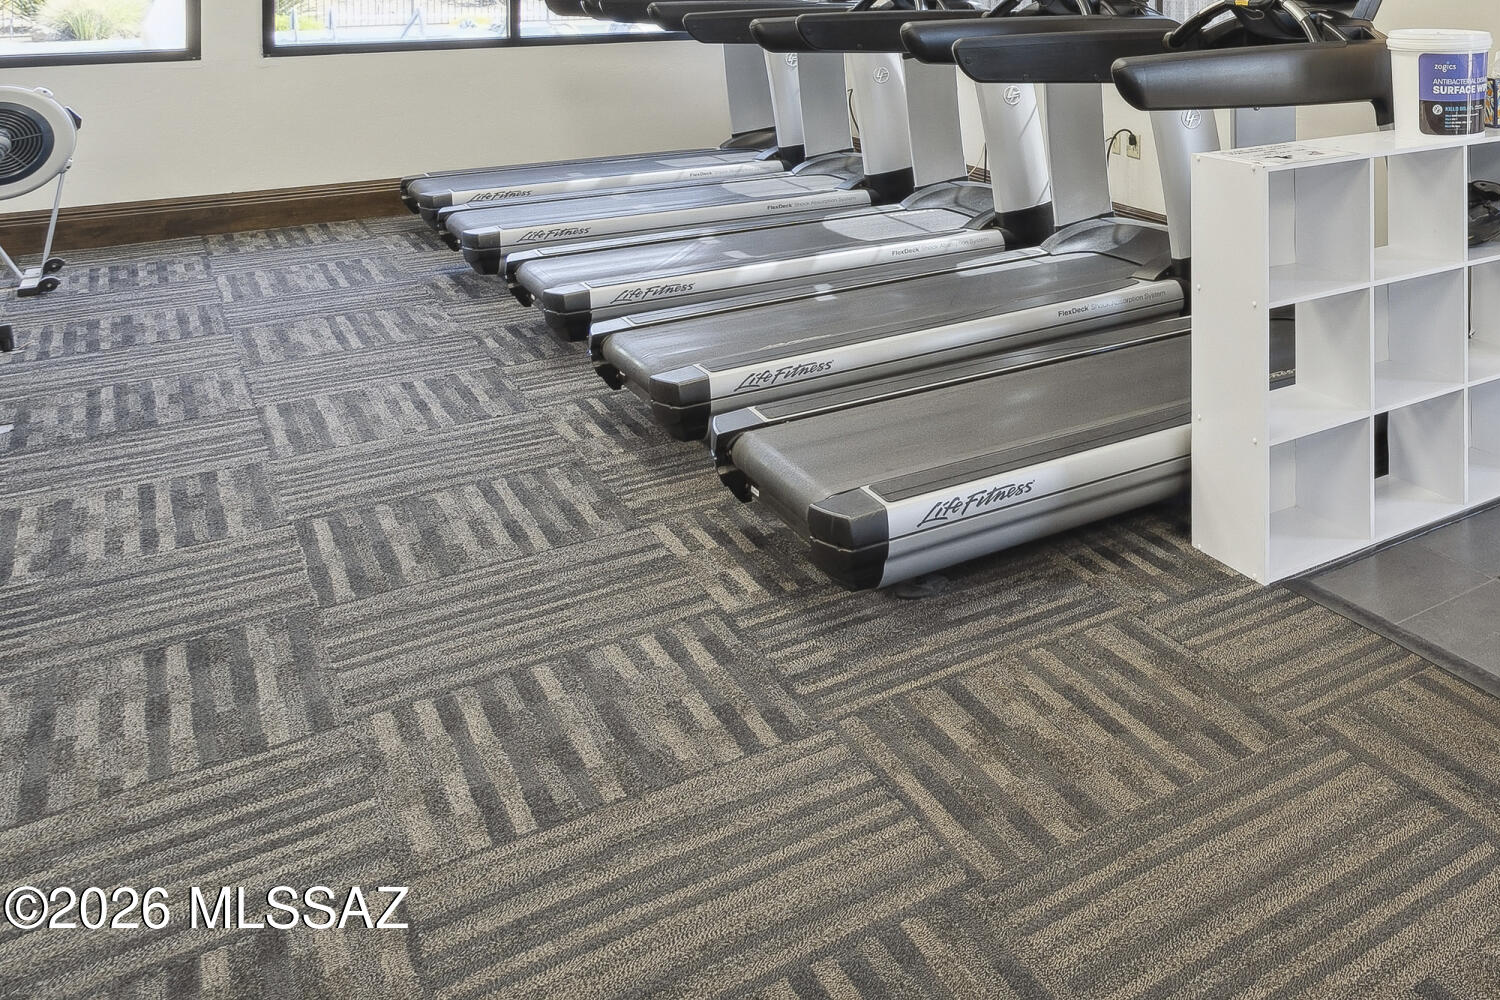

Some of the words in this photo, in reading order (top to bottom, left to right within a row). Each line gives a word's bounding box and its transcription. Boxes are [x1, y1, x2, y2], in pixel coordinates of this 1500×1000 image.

[1434, 62, 1457, 73] zogics
[1432, 84, 1476, 95] SURFACE
[767, 203, 793, 211] FlexDeck
[891, 247, 920, 256] FlexDeck
[1057, 304, 1089, 318] FlexDeck
[1144, 289, 1166, 301] System
